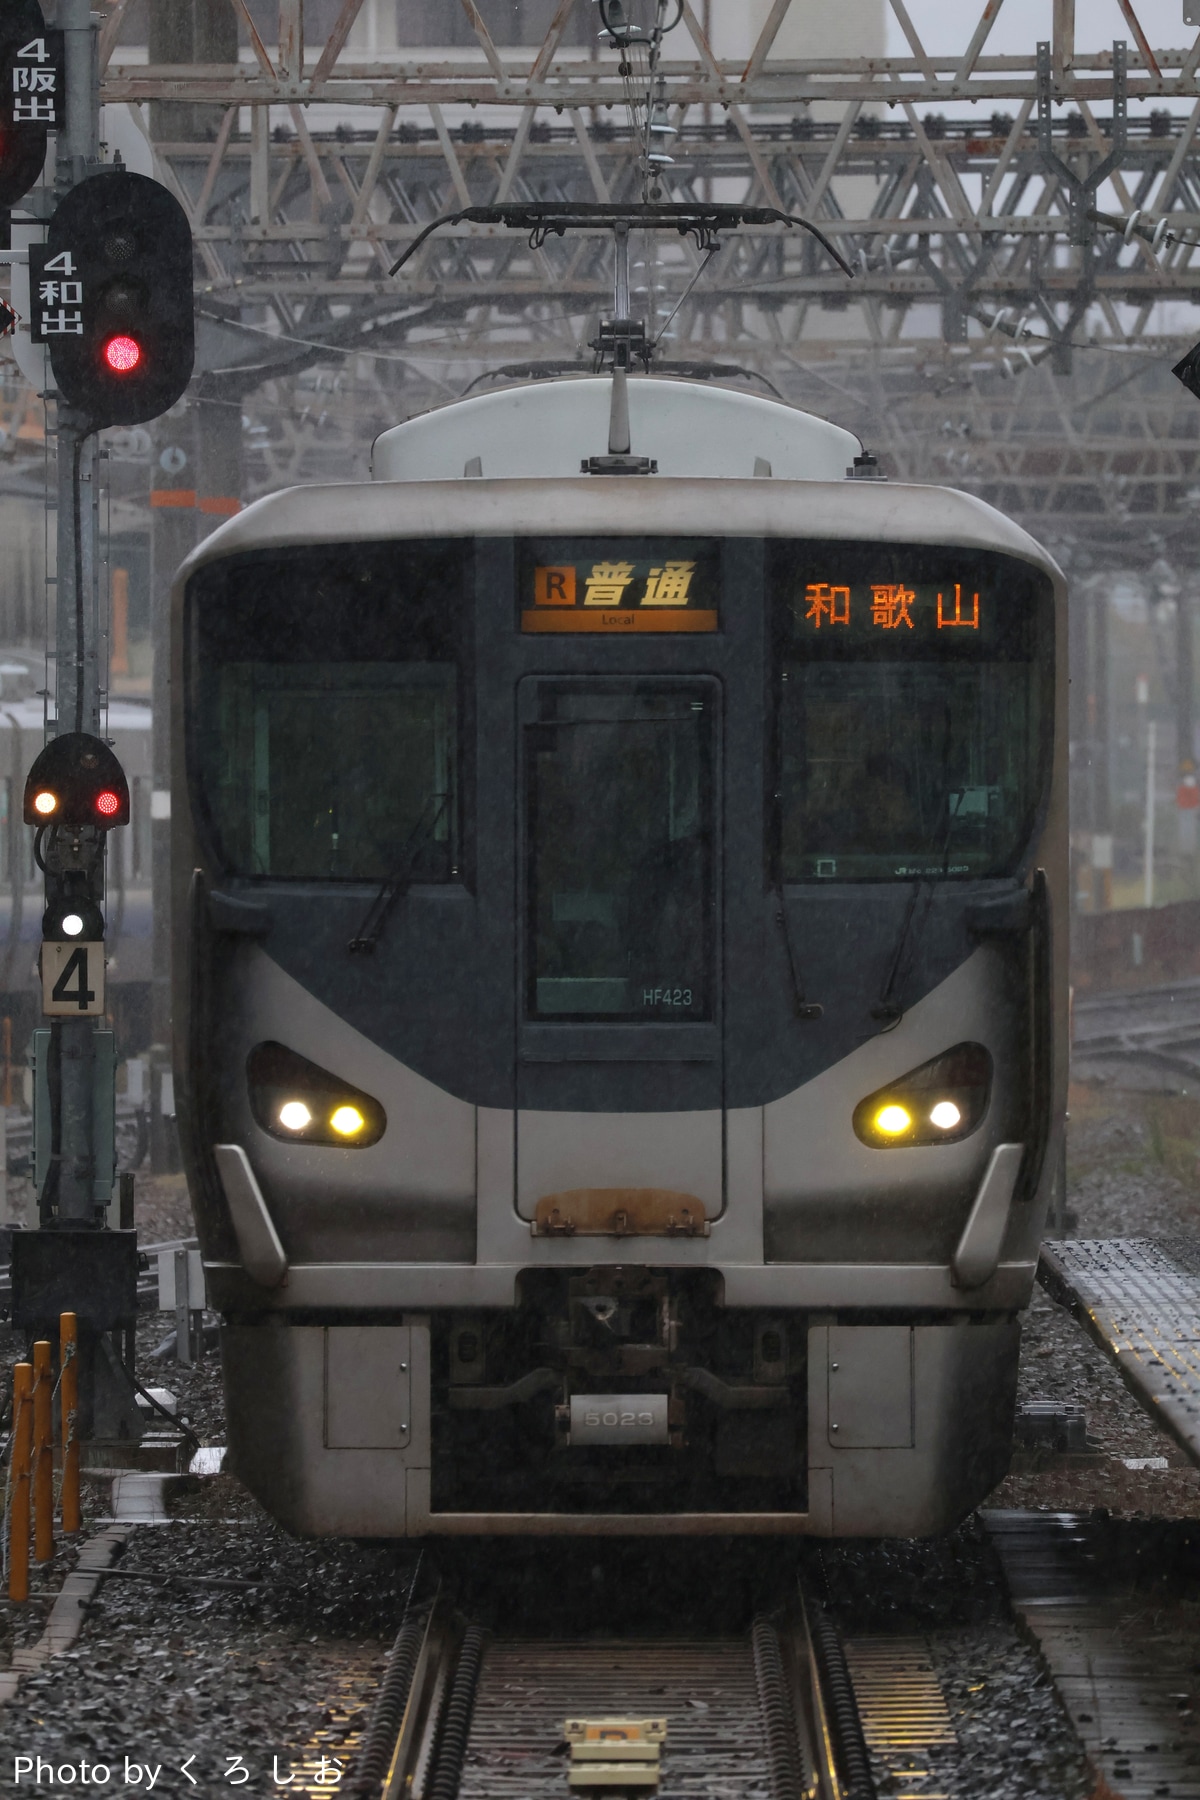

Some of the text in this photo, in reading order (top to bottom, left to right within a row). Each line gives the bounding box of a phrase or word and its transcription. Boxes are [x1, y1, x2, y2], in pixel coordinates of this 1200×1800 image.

[13, 38, 56, 122] 4阪出
[39, 251, 83, 335] 4和出
[546, 572, 567, 600] R
[584, 561, 698, 606] 普通
[805, 582, 980, 629] 和歌山
[602, 614, 635, 625] Local
[52, 948, 95, 1010] 4
[643, 989, 692, 1005] HF423
[585, 1412, 653, 1426] 5023
